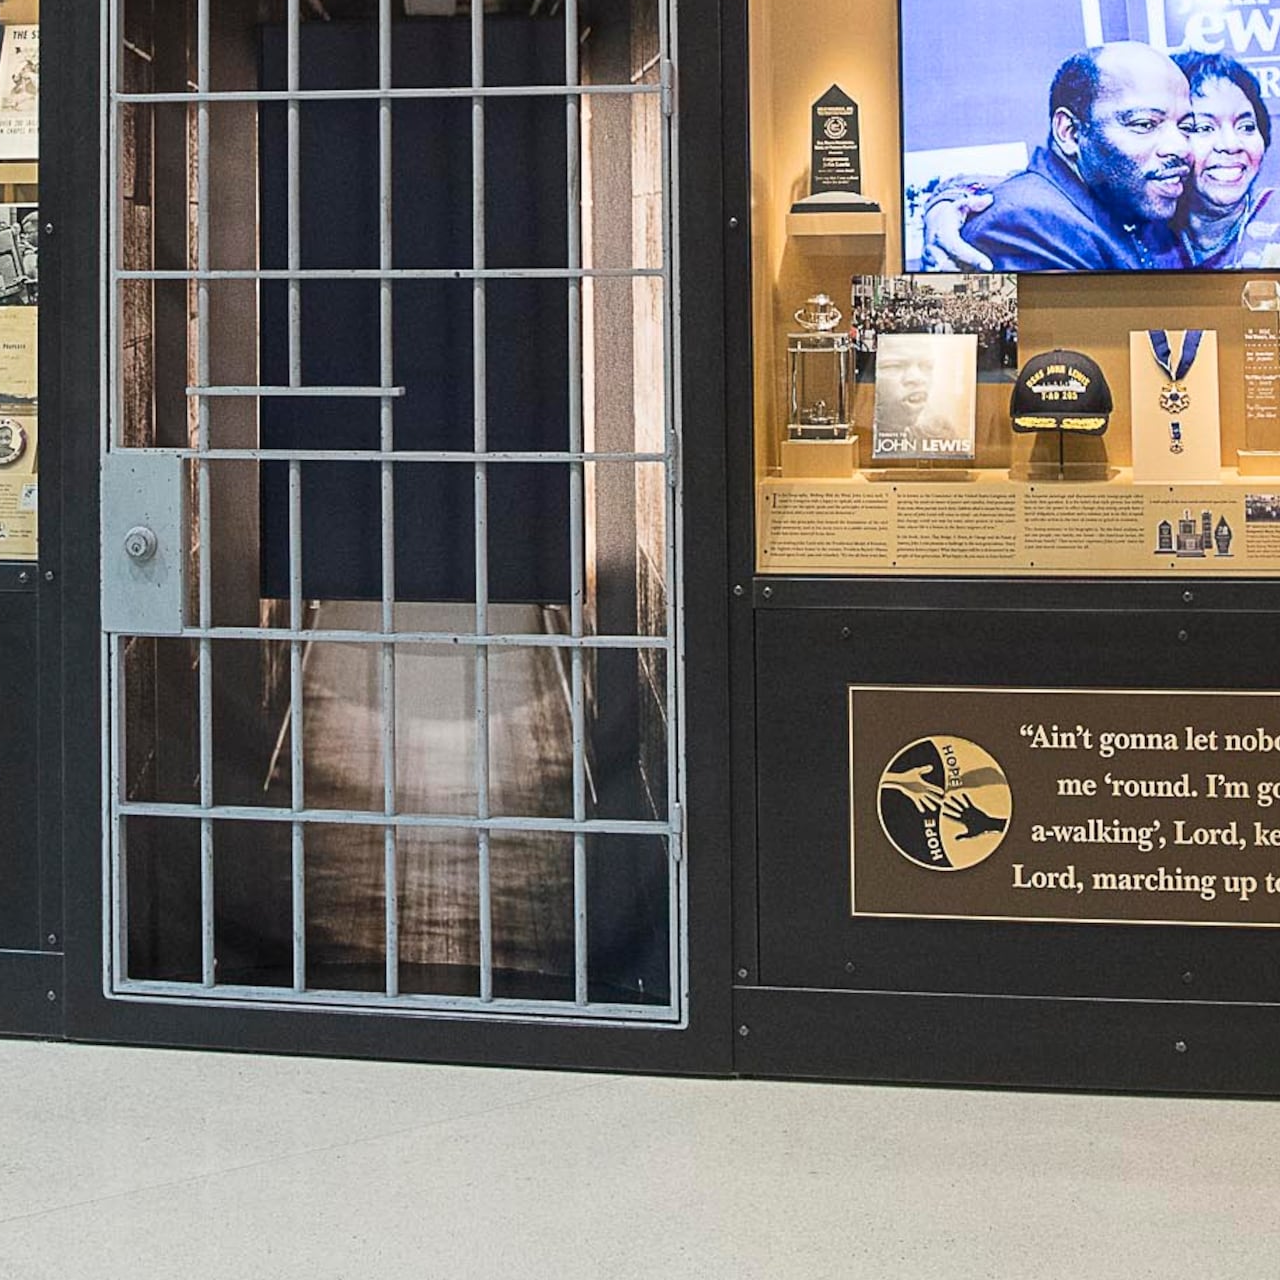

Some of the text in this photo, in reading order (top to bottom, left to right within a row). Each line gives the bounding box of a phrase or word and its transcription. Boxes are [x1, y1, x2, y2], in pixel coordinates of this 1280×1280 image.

[875, 438, 971, 453] JOHN LEWIS
[1020, 724, 1093, 749] "Ain't
[1100, 733, 1178, 757] gonna
[1186, 727, 1218, 750] let
[943, 744, 961, 789] HOPE
[1057, 779, 1096, 795] me
[1105, 773, 1198, 797] 'round.
[1206, 774, 1250, 798] I'm
[924, 818, 943, 862] HOPE
[1032, 819, 1166, 852] a-walking',
[1174, 821, 1246, 850] Lord,
[1012, 864, 1083, 894] Lord,
[1092, 867, 1216, 900] marching
[1223, 876, 1257, 900] up
